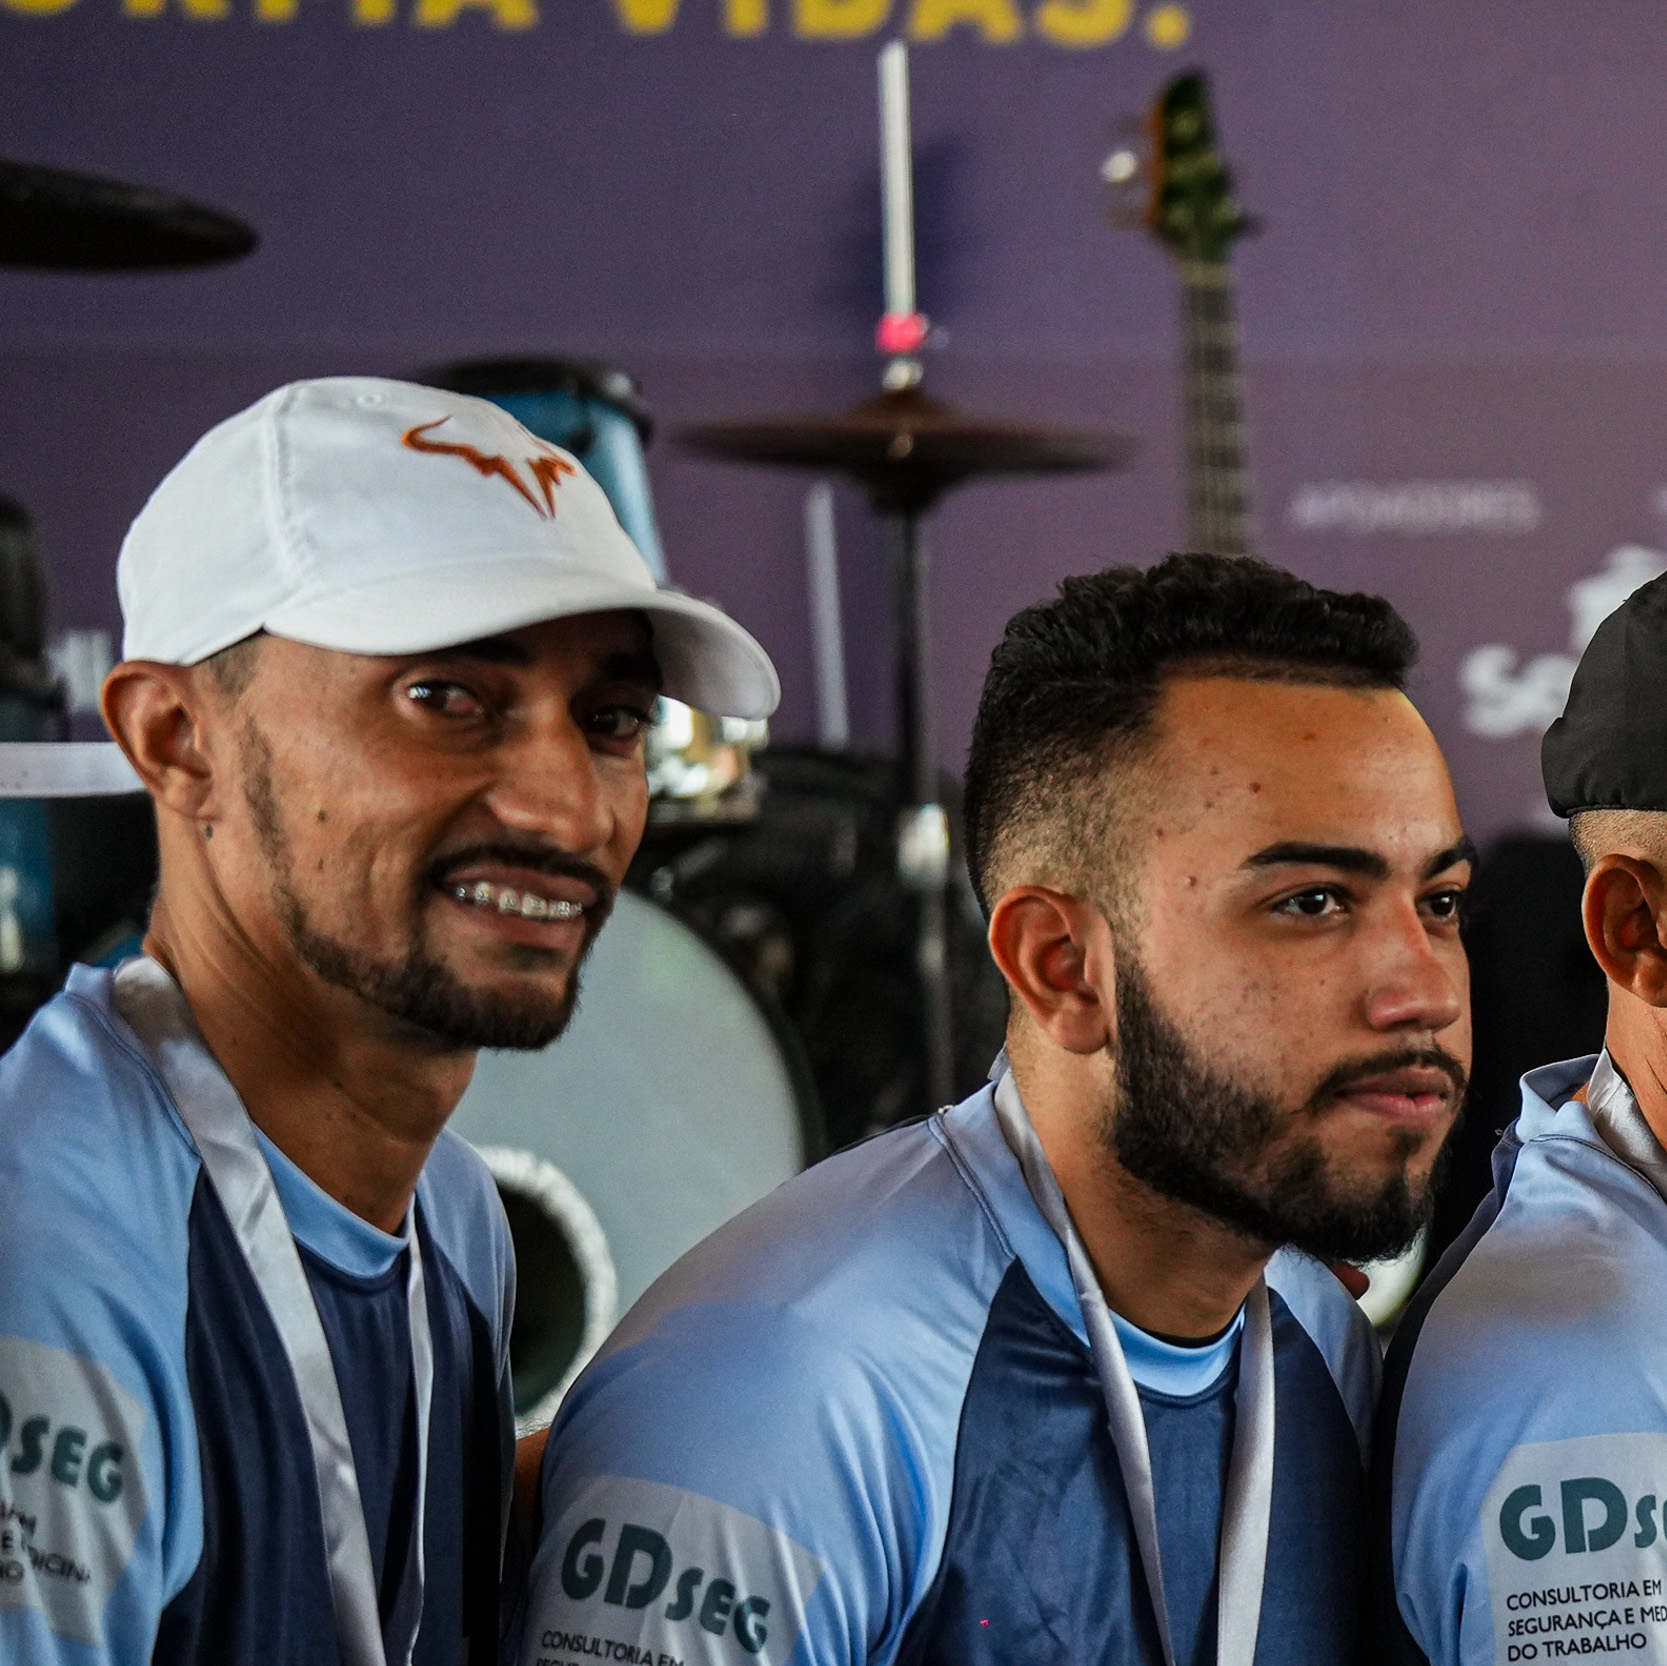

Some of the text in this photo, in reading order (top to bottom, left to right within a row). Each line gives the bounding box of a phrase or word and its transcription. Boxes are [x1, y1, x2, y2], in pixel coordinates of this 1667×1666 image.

[1506, 1579, 1661, 1612] CONSULTORIA EM
[1508, 1610, 1621, 1638] SEGURANÇA
[1625, 1608, 1635, 1624] E
[1507, 1632, 1647, 1662] DO TRABALHO
